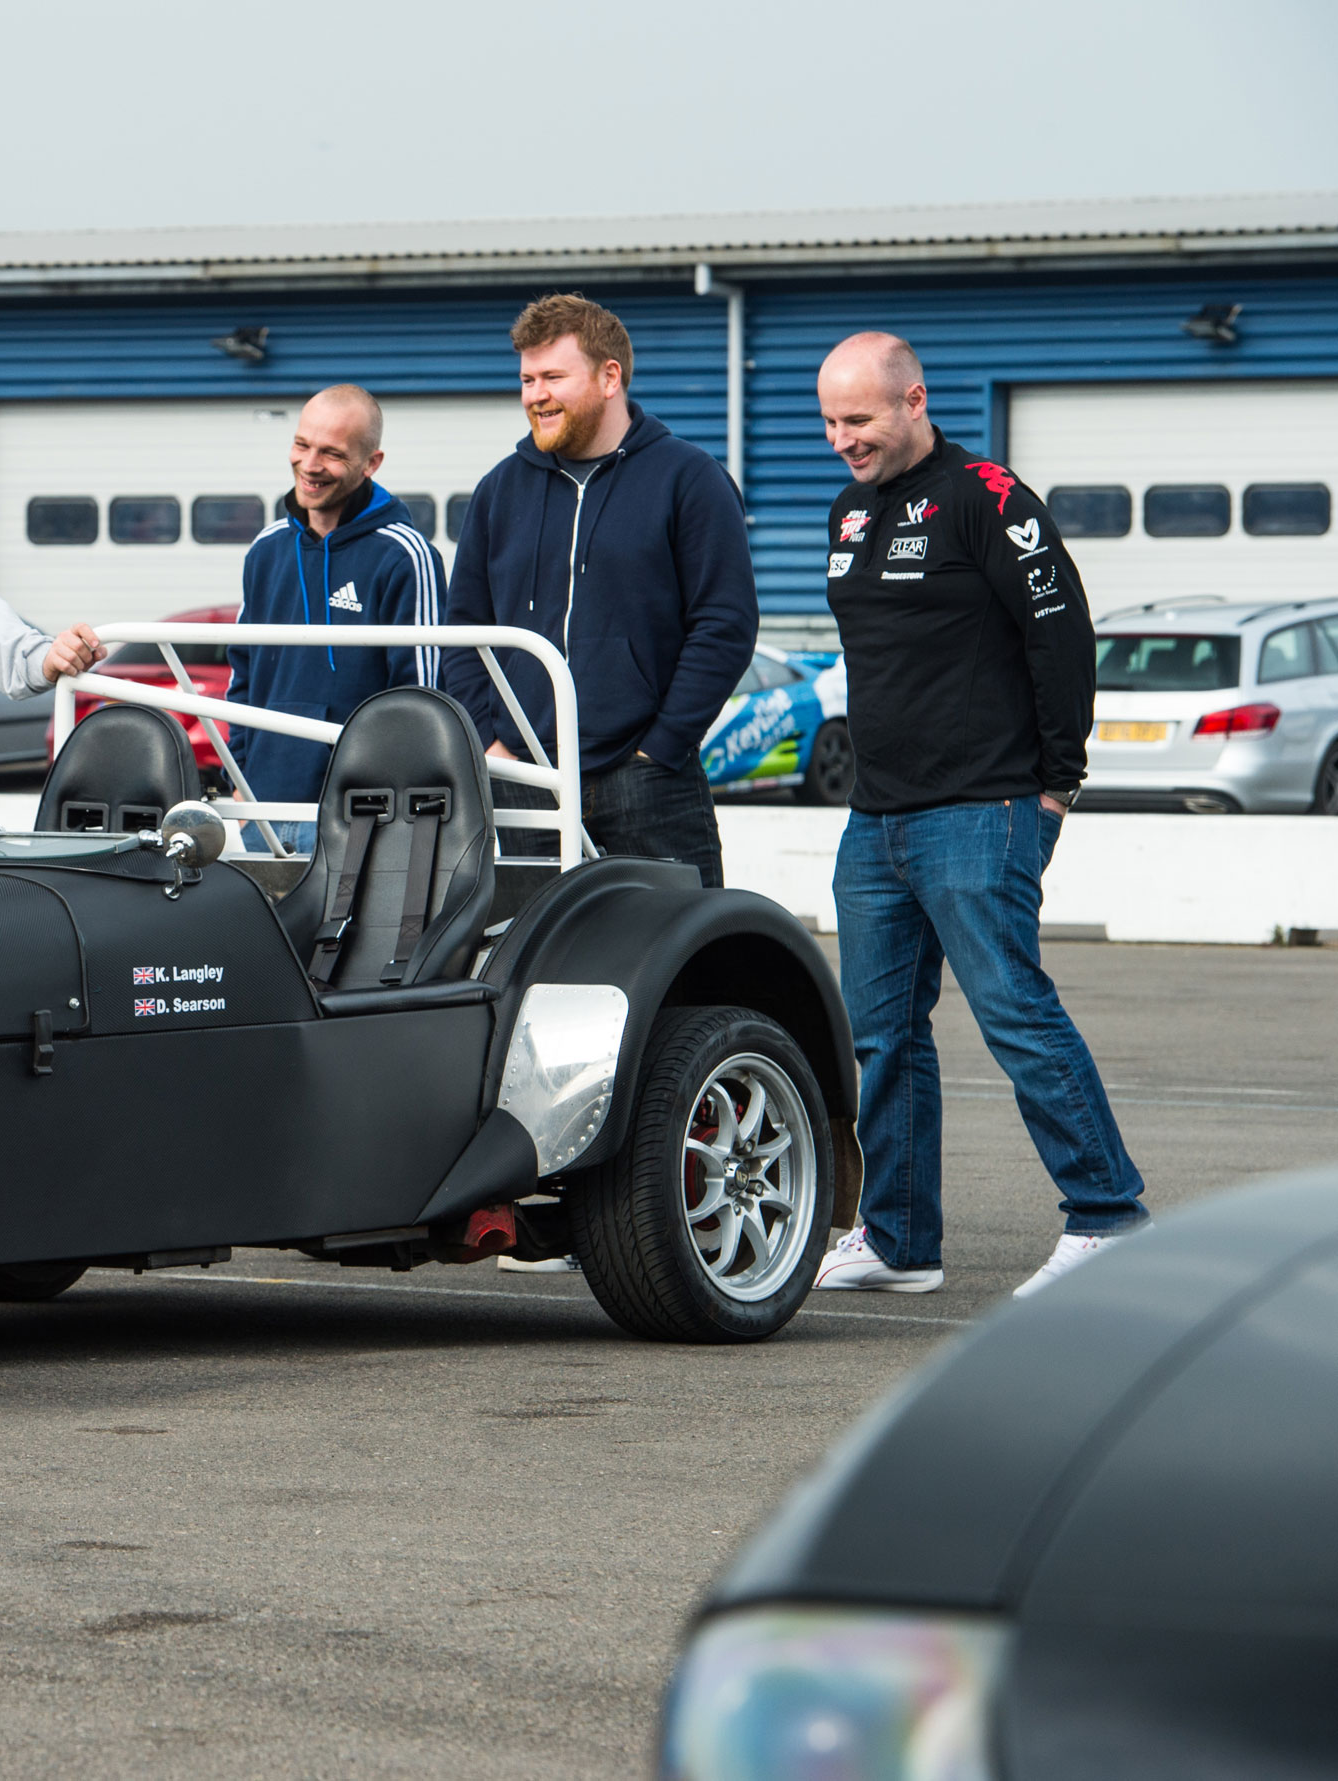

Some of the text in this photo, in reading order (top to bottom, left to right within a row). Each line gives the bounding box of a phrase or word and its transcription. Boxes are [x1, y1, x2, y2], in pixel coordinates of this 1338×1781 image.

[892, 541, 924, 553] CLEAR
[329, 597, 363, 612] adidas
[155, 964, 224, 983] K. Langley
[156, 997, 226, 1014] D. Searson
